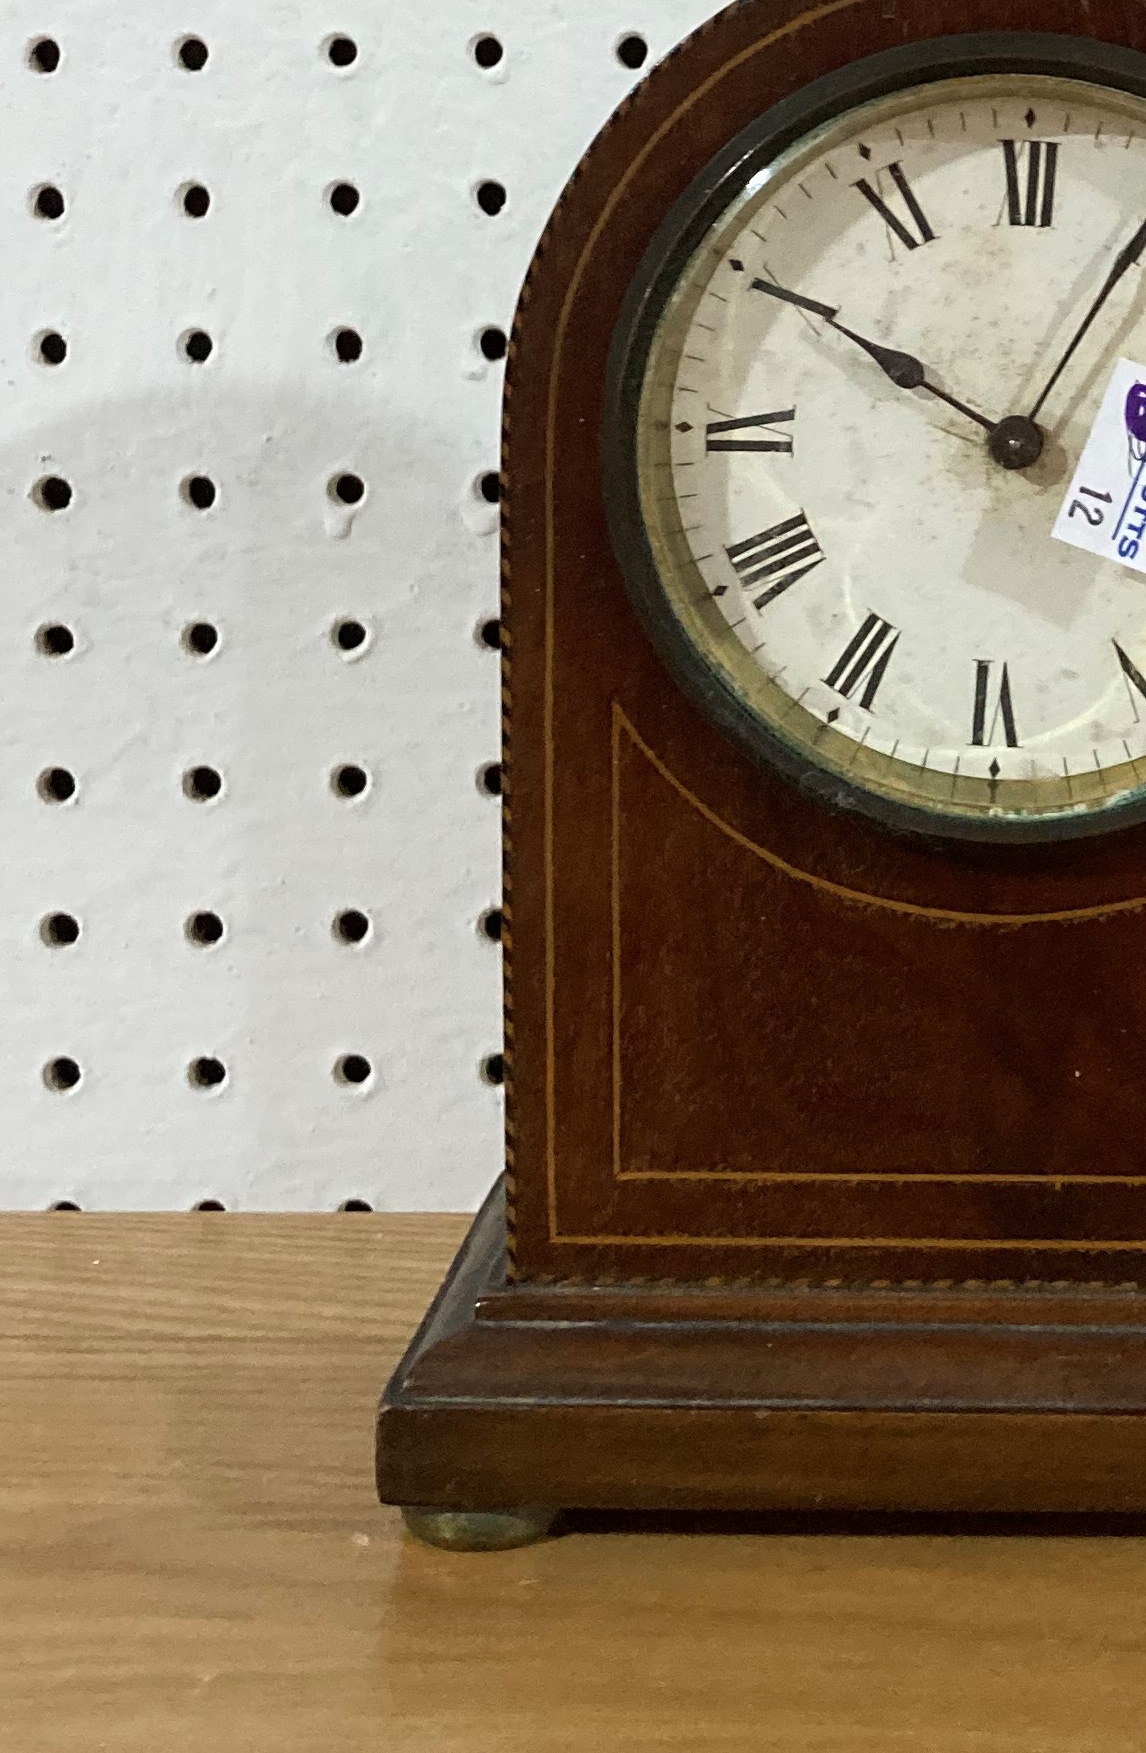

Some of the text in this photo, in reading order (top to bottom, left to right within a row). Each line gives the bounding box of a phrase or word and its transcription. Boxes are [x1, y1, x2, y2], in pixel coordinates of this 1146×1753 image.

[849, 159, 942, 262] XI
[992, 138, 1061, 229] XII
[746, 261, 842, 342] X
[704, 403, 797, 458] IX
[1068, 484, 1113, 528] 12
[724, 507, 827, 616] VIII
[820, 607, 902, 714] VII
[966, 658, 1025, 748] VI
